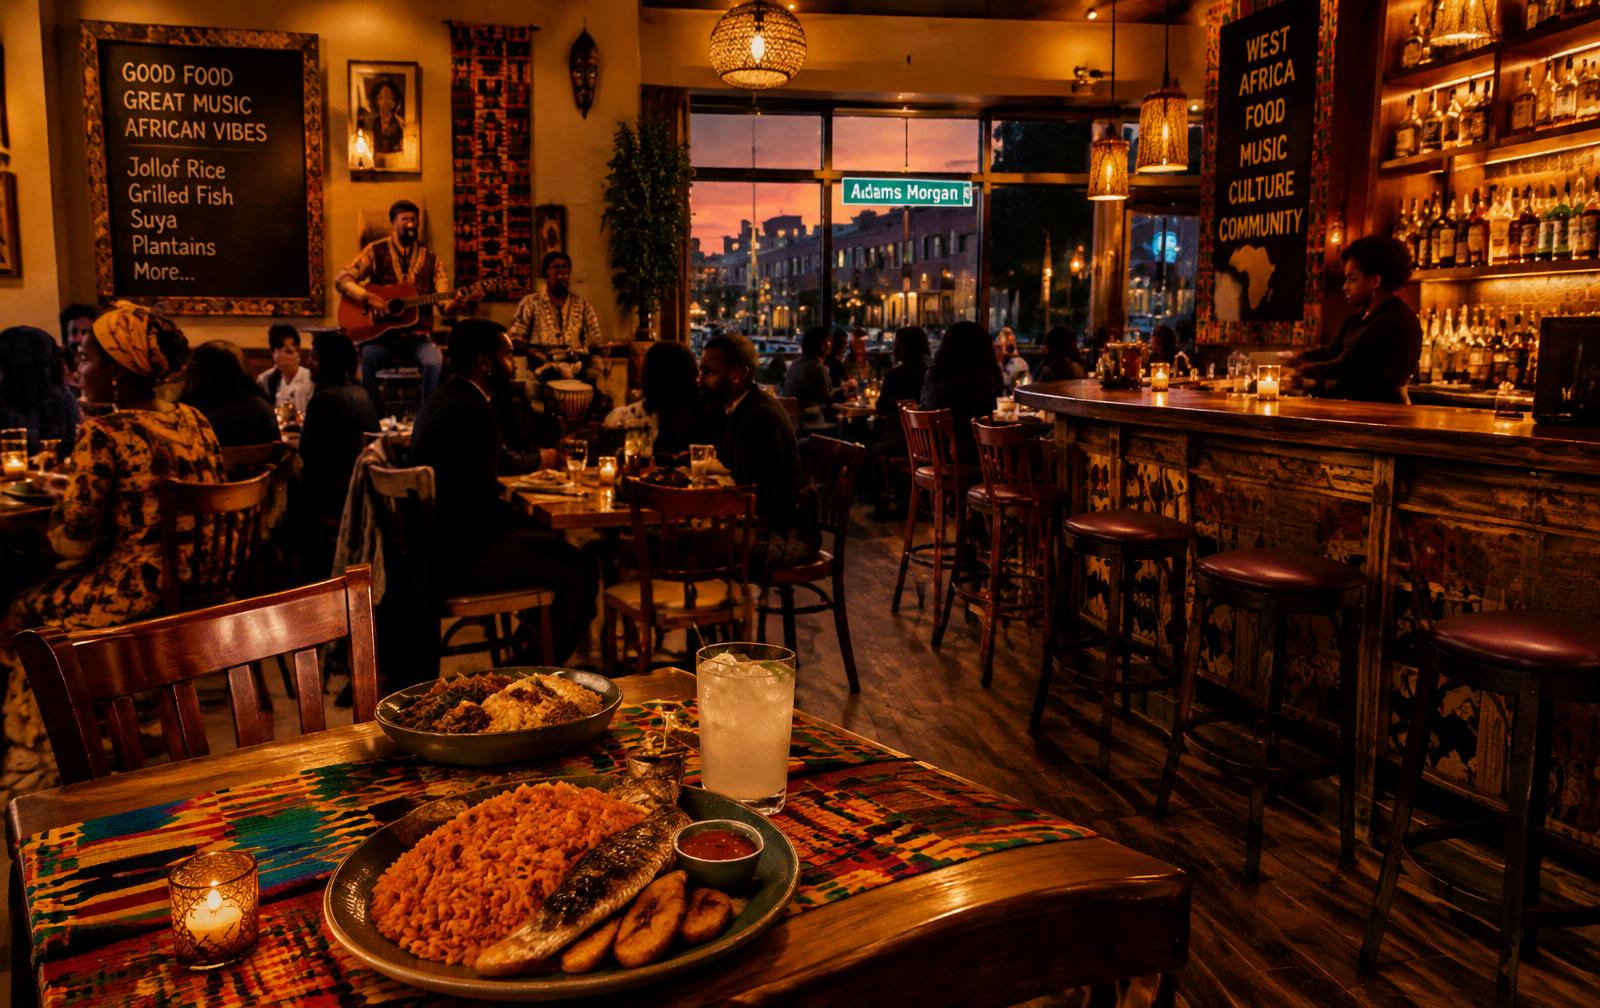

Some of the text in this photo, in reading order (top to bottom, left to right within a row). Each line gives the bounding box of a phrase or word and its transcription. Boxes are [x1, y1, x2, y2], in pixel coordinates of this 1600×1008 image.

[1245, 25, 1291, 64] WEST
[121, 61, 233, 87] GOOD FOOD
[1238, 58, 1296, 96] AFRICA
[122, 89, 252, 115] GREAT MUSIC
[1245, 98, 1285, 130] FOOD
[124, 117, 268, 143] AFRICAN VIBES
[1239, 134, 1287, 168] MUSIC
[127, 156, 226, 180] Jollof Rice
[128, 182, 234, 206] Grilled Fish
[906, 184, 959, 203] Morgan
[1228, 170, 1295, 205] CULTURE
[130, 208, 178, 234] Suya
[1219, 207, 1303, 243] COMMUNITY
[132, 234, 217, 256] Plantains
[134, 261, 195, 281] More...
